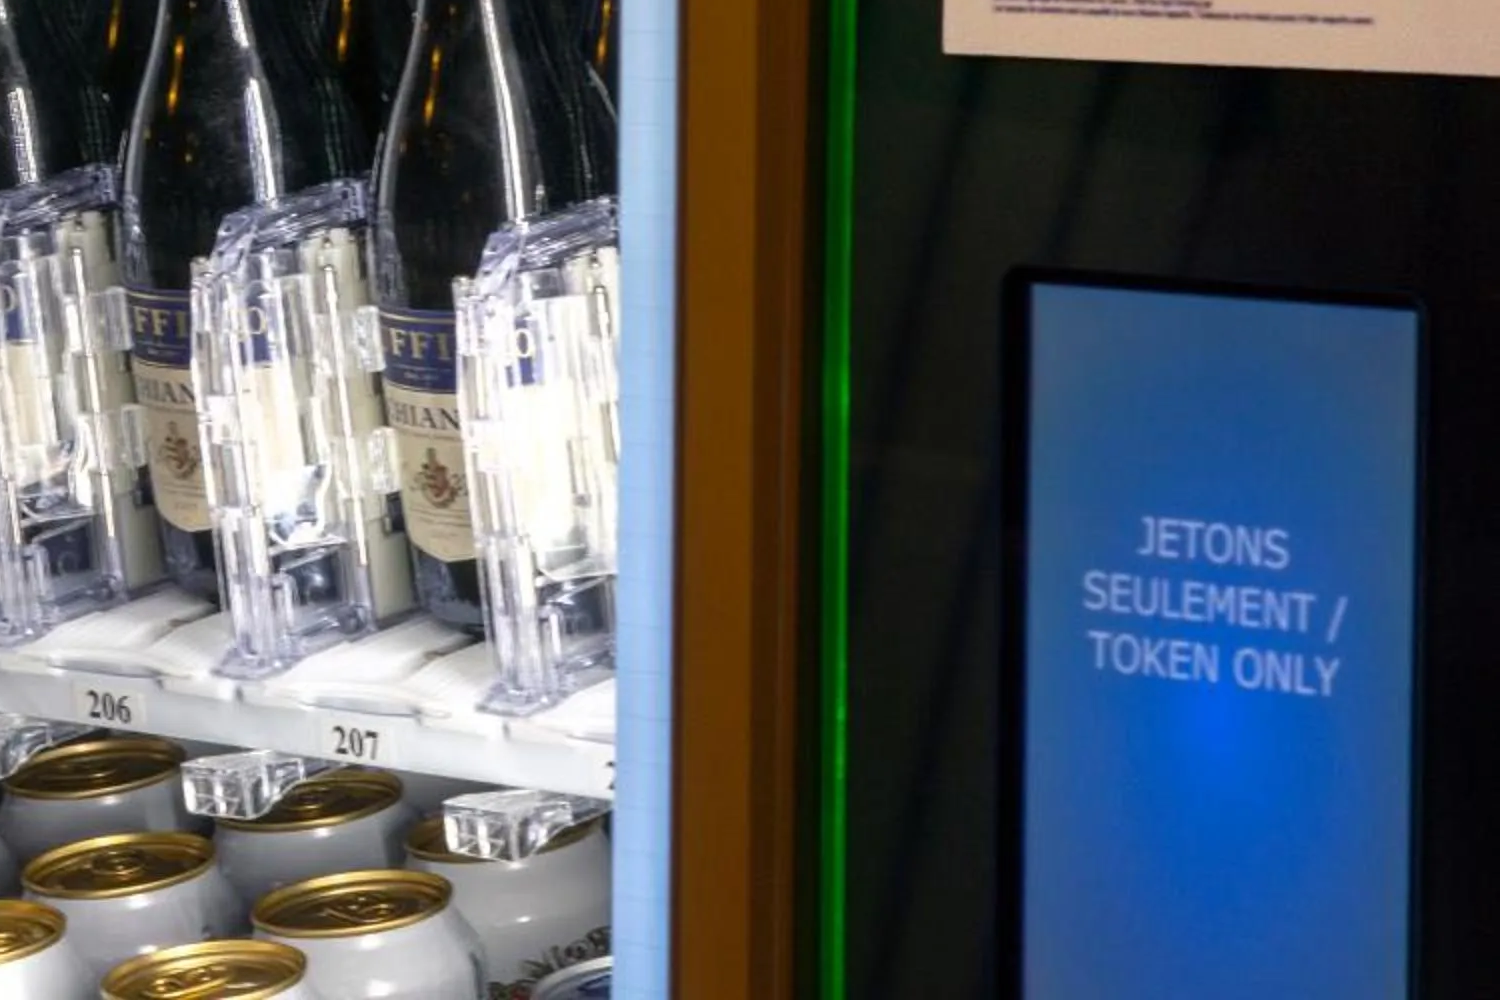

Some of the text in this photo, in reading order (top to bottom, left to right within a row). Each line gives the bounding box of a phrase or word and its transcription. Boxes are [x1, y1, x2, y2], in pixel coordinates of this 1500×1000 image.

[1138, 517, 1289, 569] JETONS
[1083, 570, 1349, 644] SEULEMENT /
[1087, 629, 1341, 697] TOKEN ONLY
[87, 688, 133, 725] 206
[333, 724, 380, 761] 207
